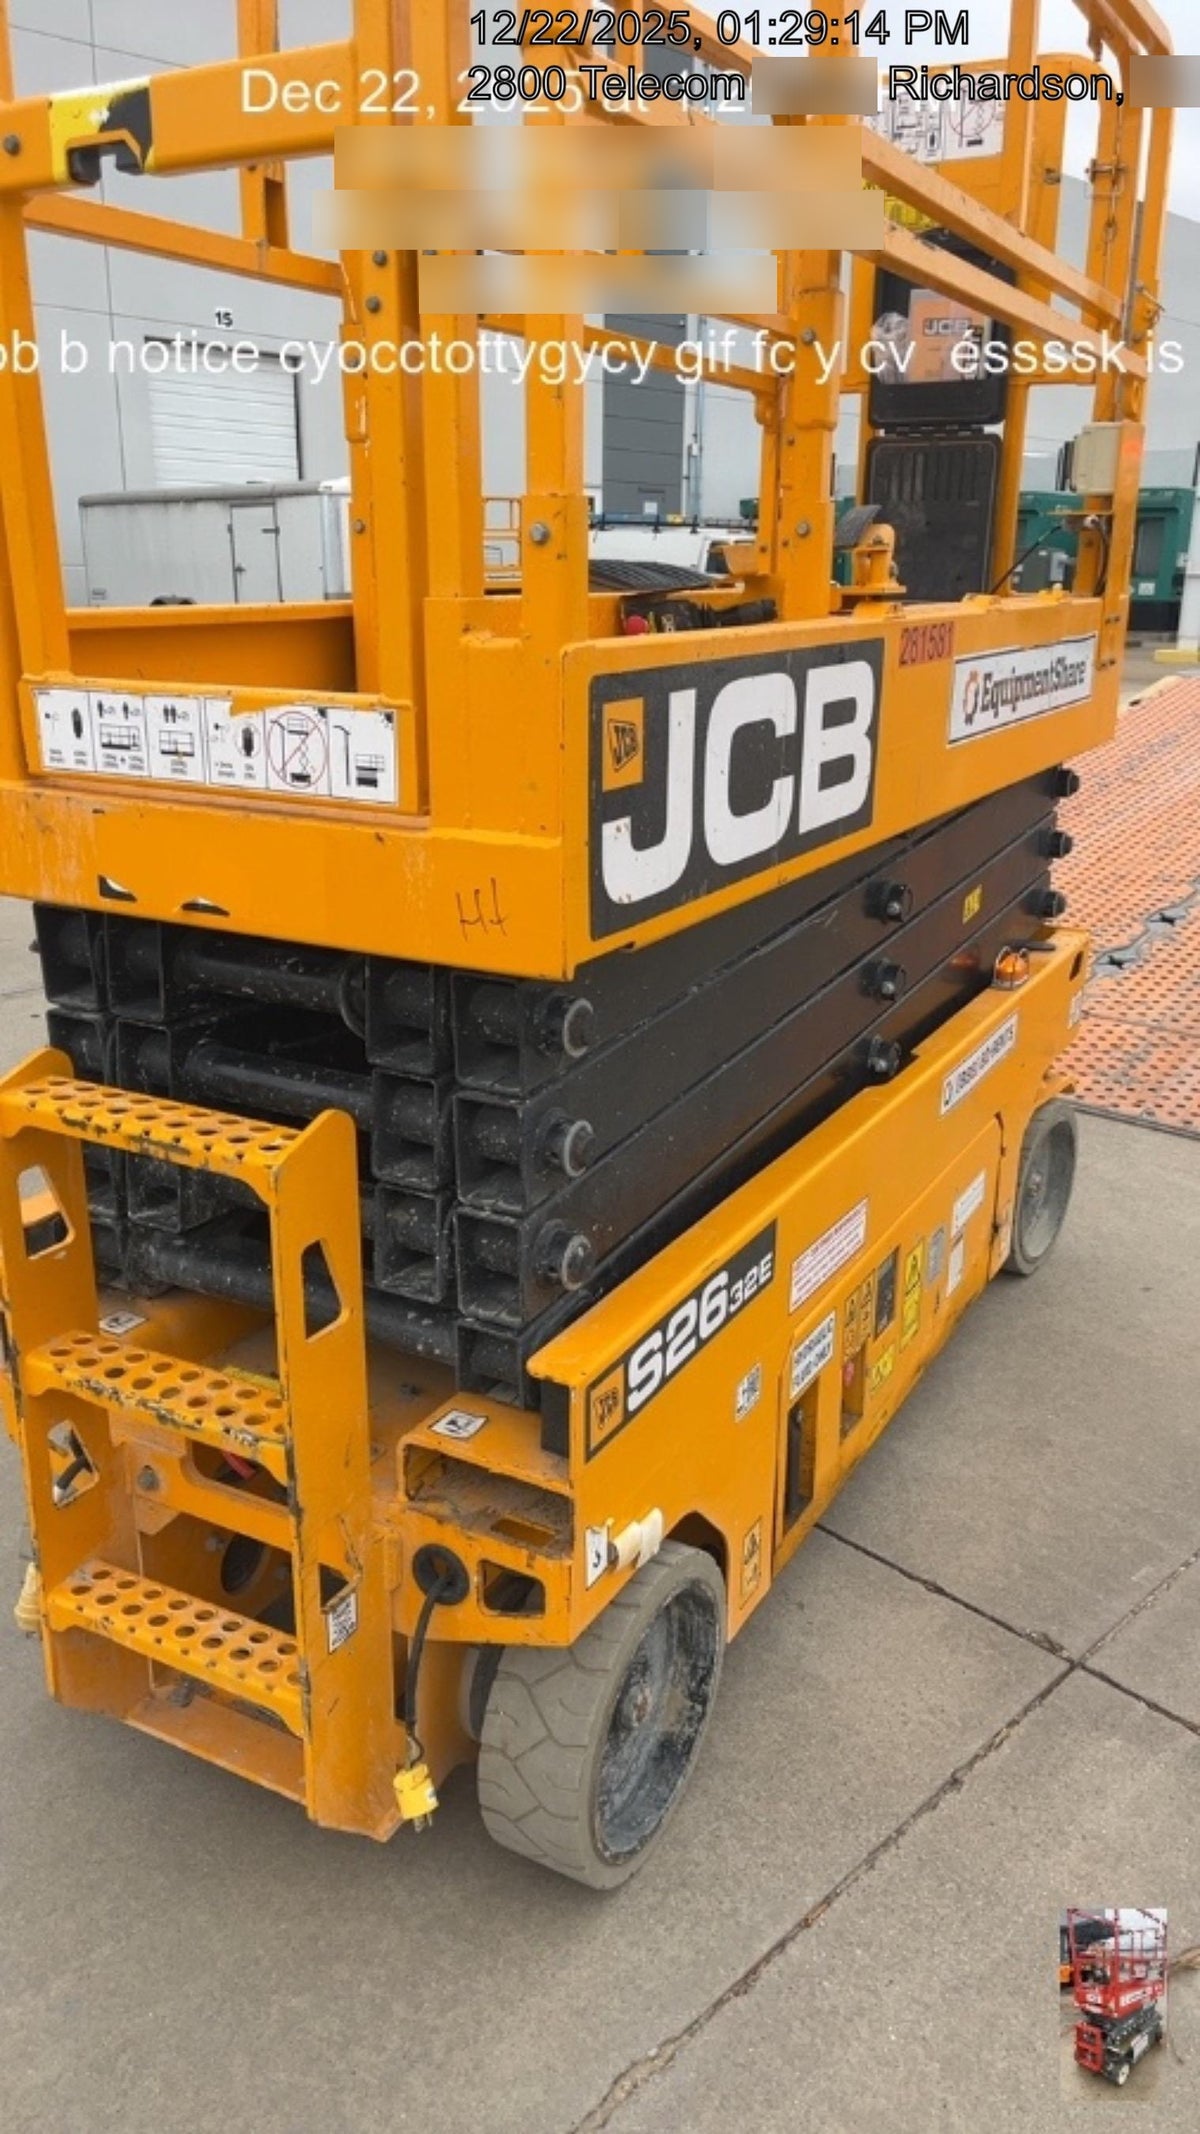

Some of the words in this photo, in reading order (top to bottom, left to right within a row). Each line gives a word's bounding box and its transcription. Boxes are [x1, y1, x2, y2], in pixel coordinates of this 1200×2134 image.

[215, 310, 233, 328] 15
[899, 622, 955, 667] 281581
[979, 656, 1087, 719] EquipmentShare
[602, 660, 876, 904] JCB
